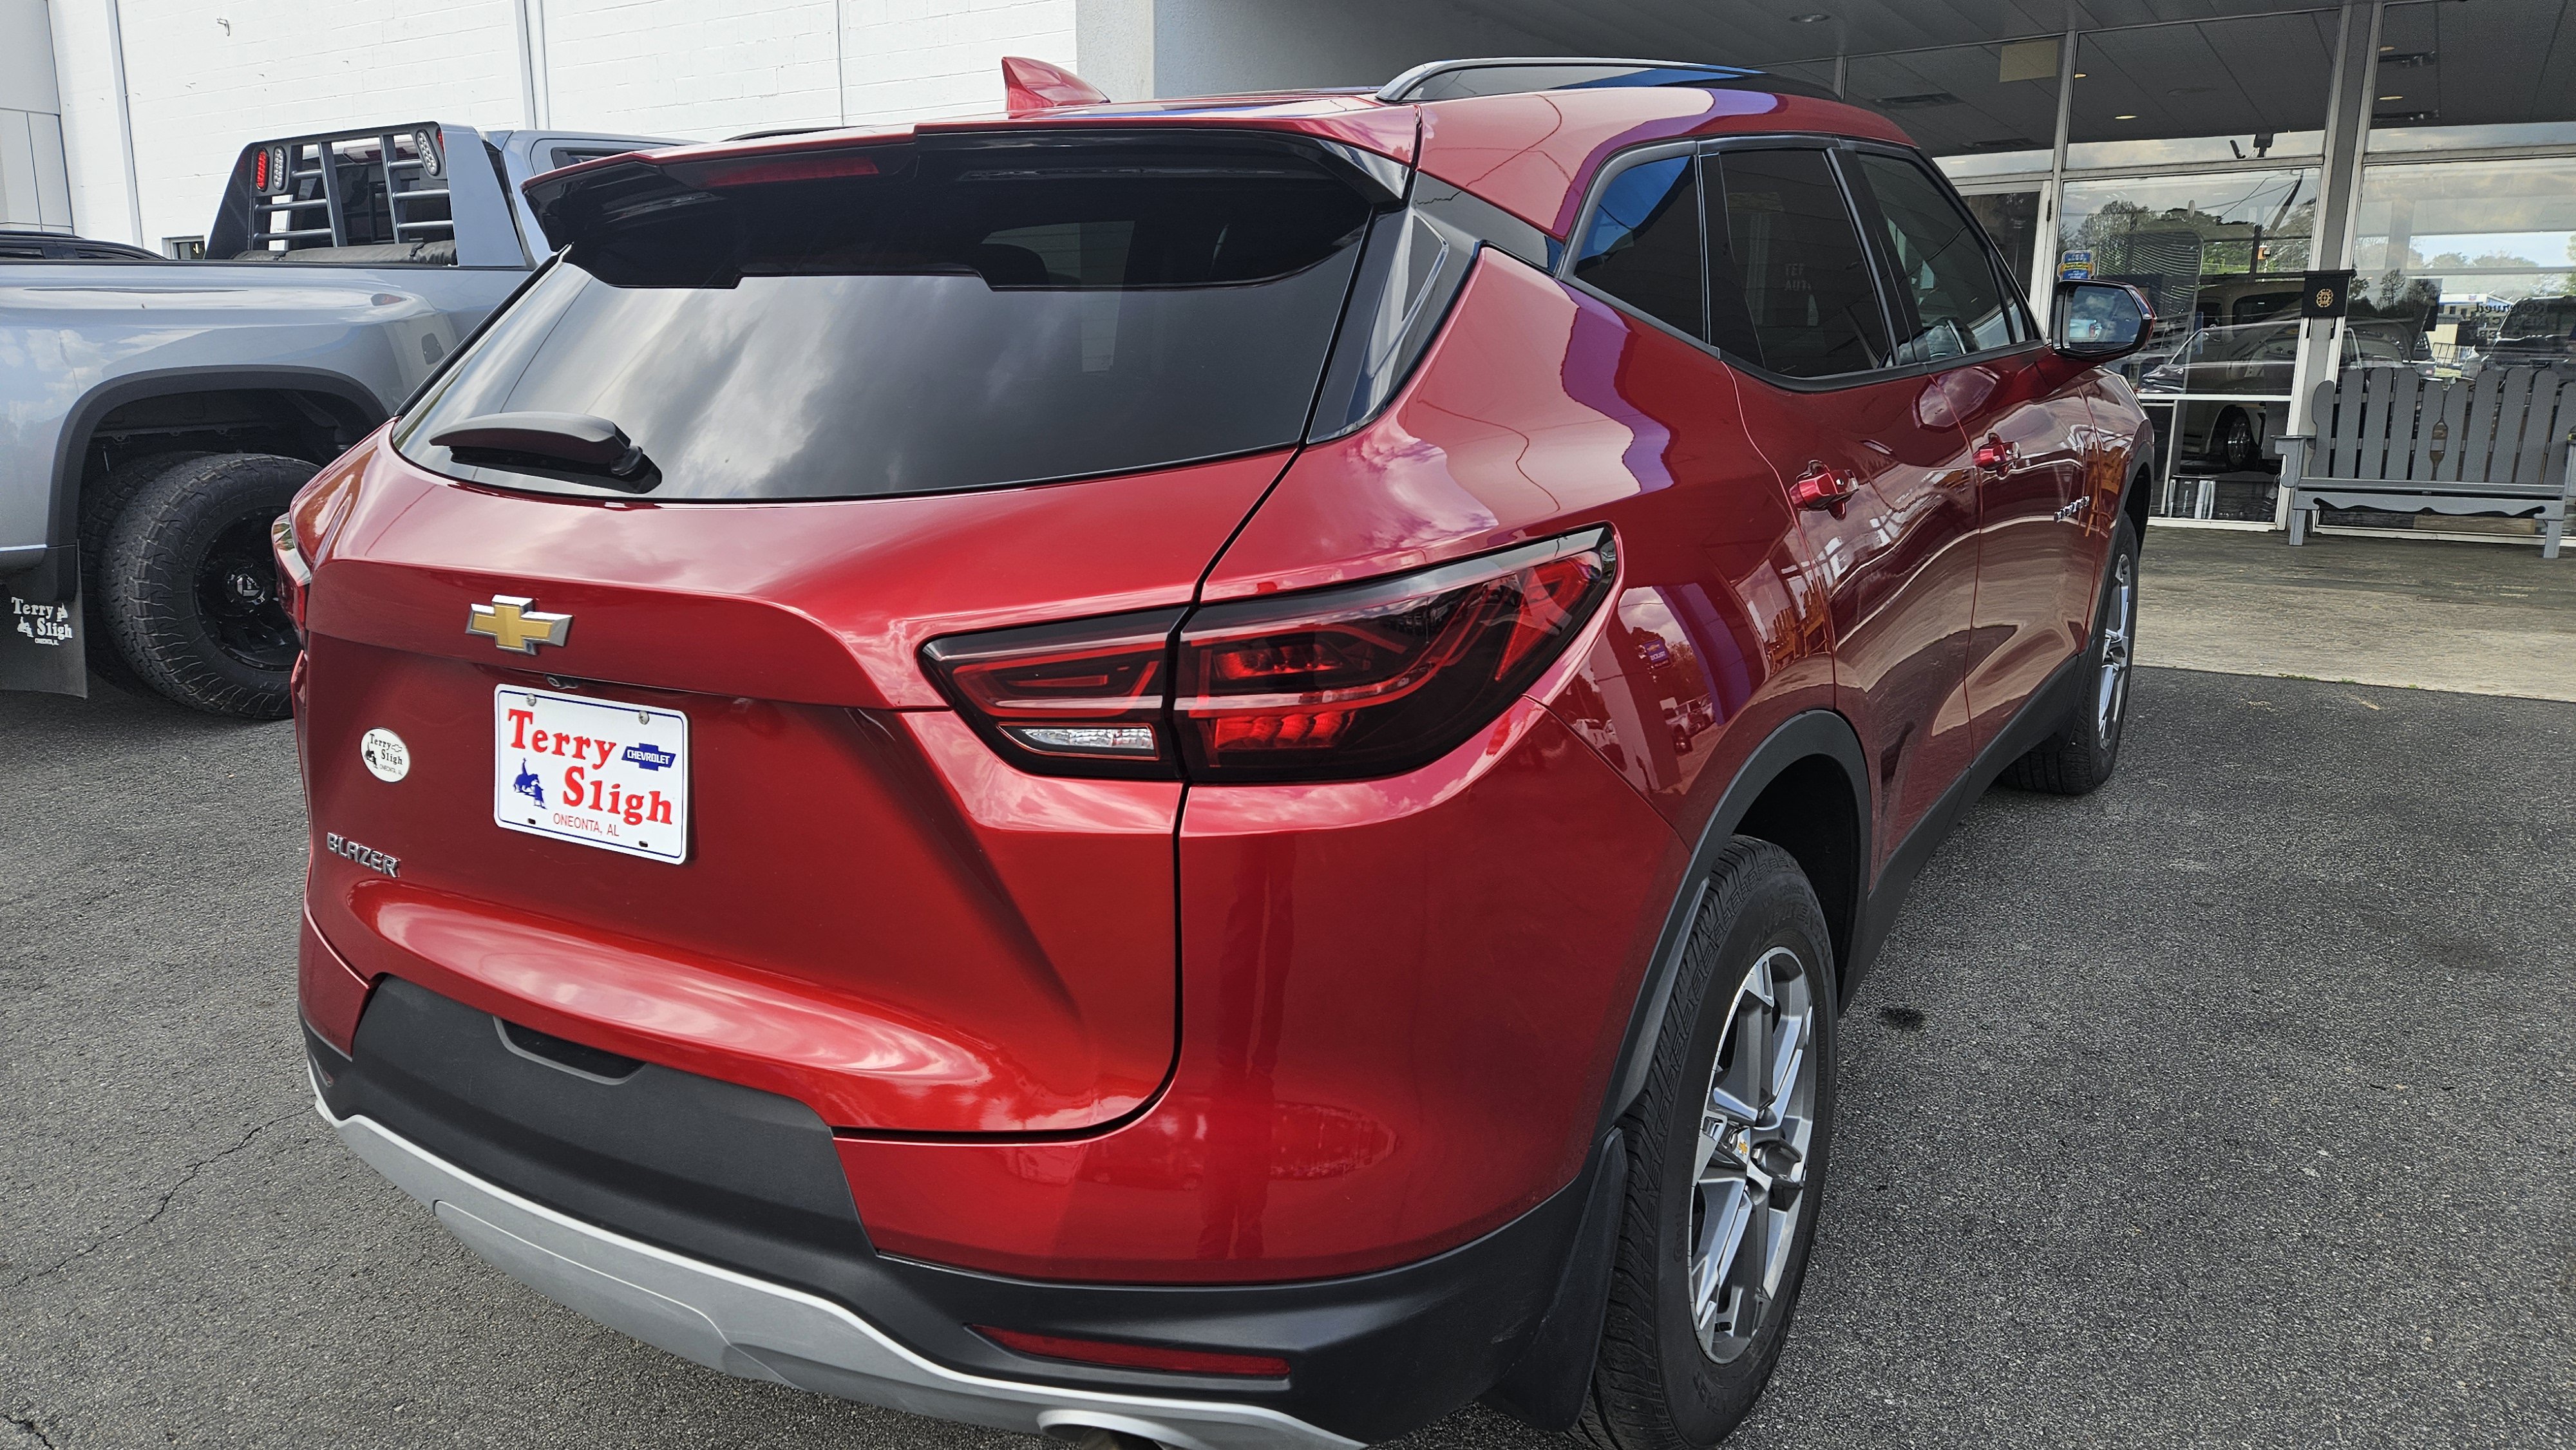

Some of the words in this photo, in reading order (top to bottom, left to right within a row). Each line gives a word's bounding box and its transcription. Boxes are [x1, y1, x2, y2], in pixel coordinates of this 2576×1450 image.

[11, 596, 54, 619] Terry
[37, 617, 73, 640] Sligh
[370, 733, 391, 750] Terry
[507, 708, 617, 771] Terry
[381, 749, 402, 765] Sligh
[627, 749, 670, 766] CHEVROLET
[563, 766, 673, 826] Sligh
[553, 813, 603, 834] ONEONTA,
[607, 824, 620, 837] AL
[327, 831, 401, 878] BLAZER
